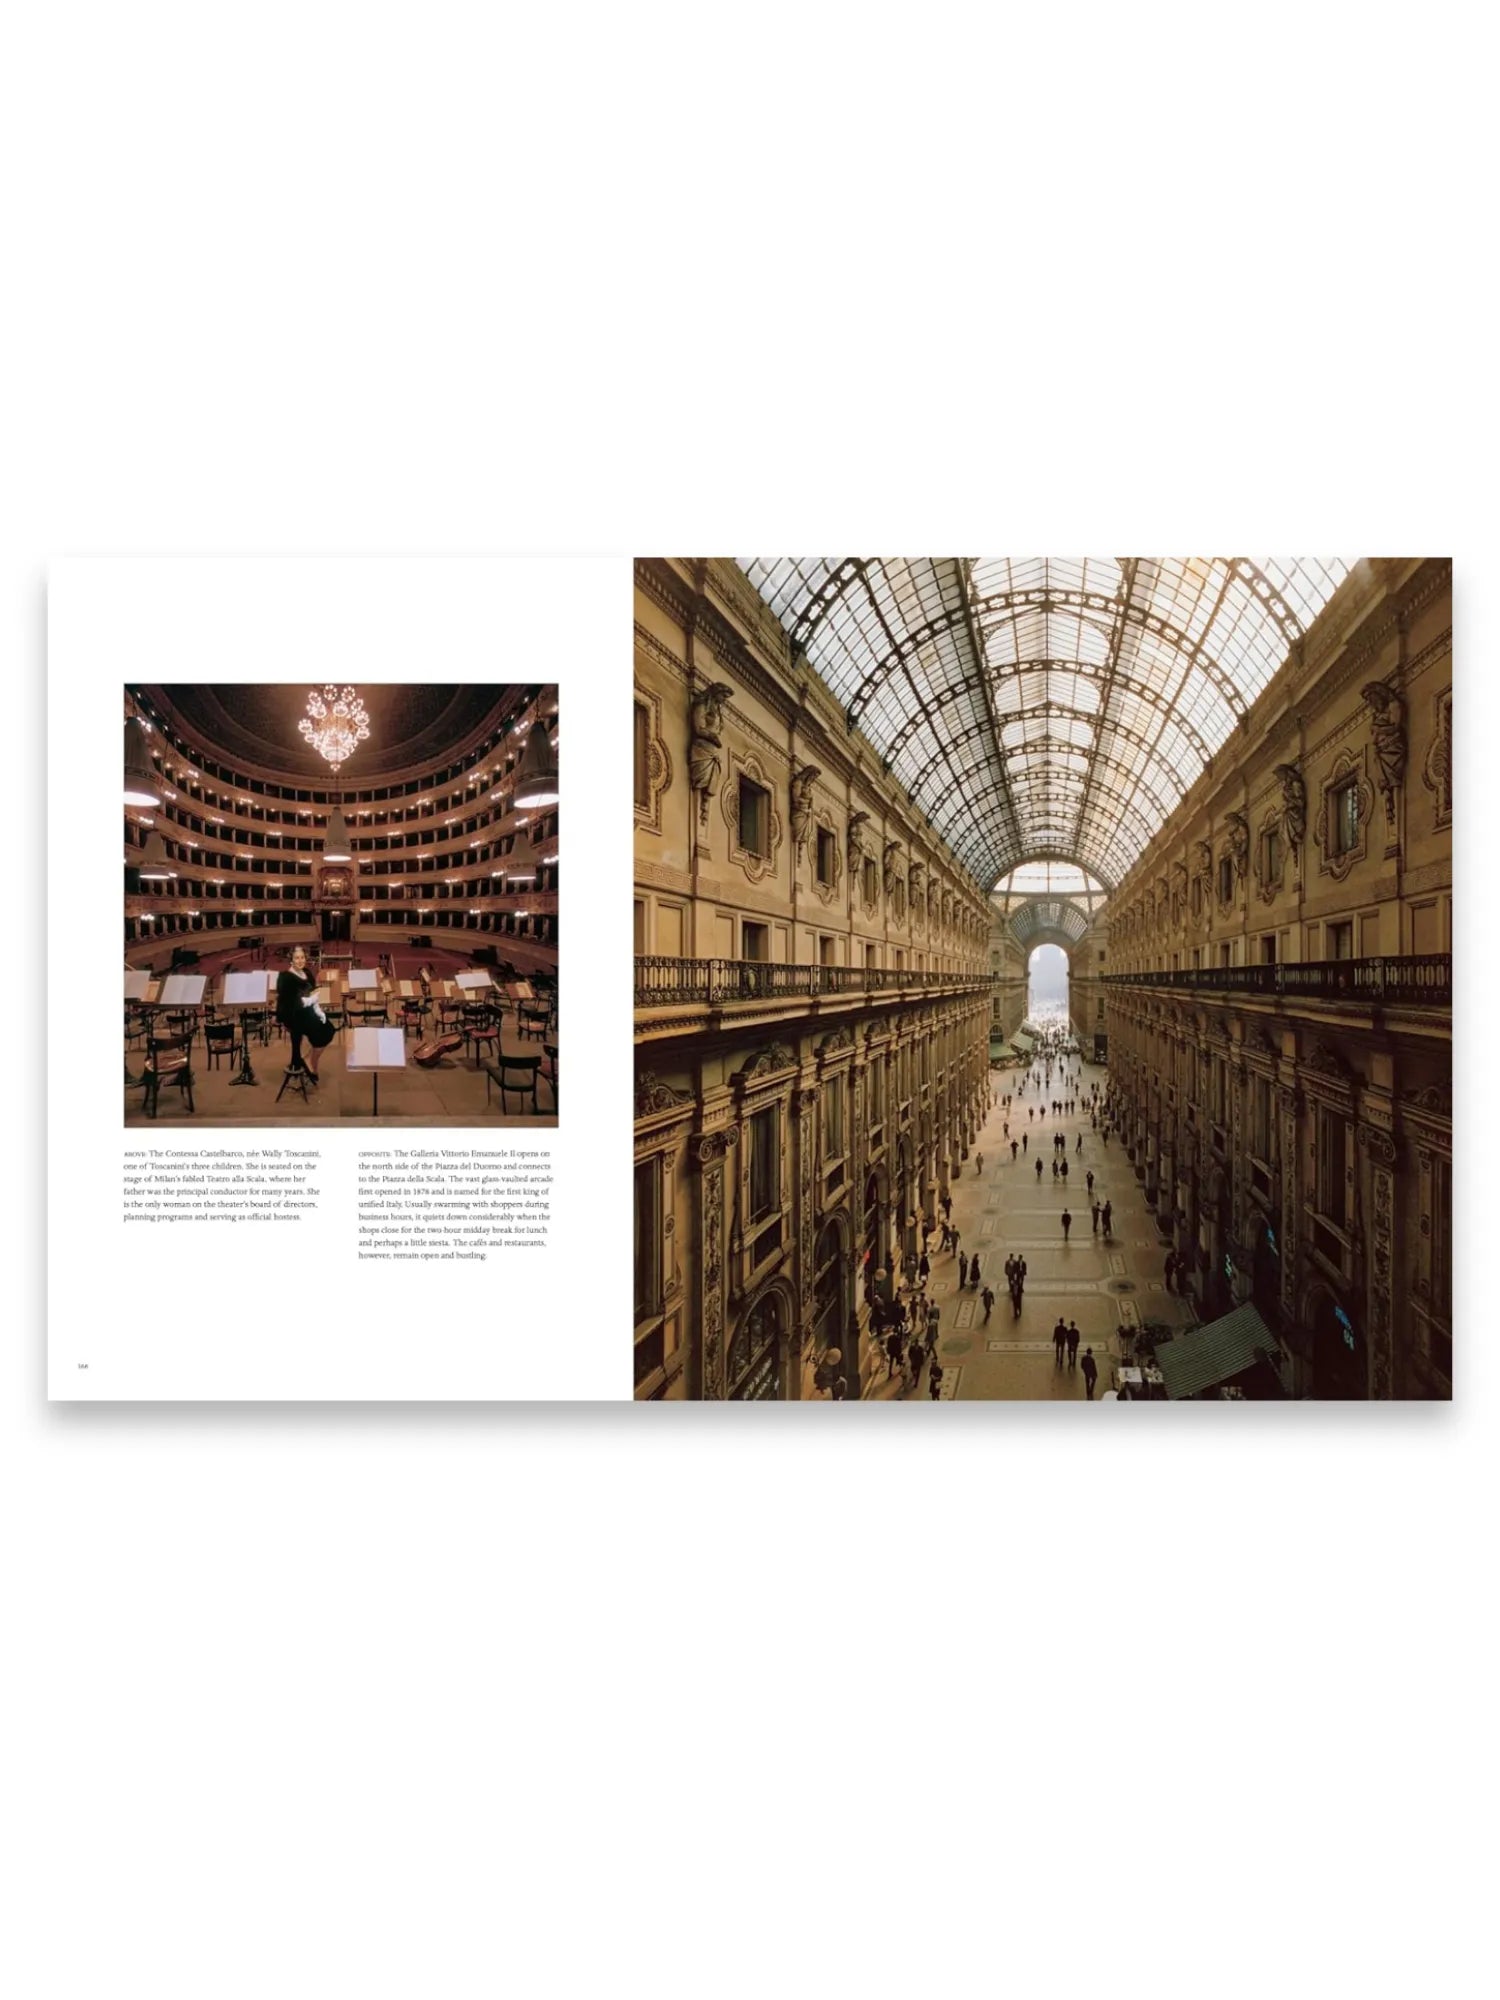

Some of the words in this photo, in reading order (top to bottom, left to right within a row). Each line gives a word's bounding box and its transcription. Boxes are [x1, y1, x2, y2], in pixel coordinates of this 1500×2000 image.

[149, 1149, 164, 1158] The
[261, 1149, 282, 1159] Wally
[394, 1149, 409, 1158] The
[410, 1149, 439, 1158] Galleria
[440, 1149, 470, 1158] Vittorio
[471, 1149, 508, 1158] Emanuele
[516, 1151, 539, 1160] opens
[138, 1162, 148, 1170] of
[191, 1162, 210, 1170] three
[245, 1162, 259, 1170] She
[268, 1162, 292, 1170] seated
[304, 1162, 317, 1170] the
[358, 1161, 371, 1170] the
[371, 1162, 393, 1171] north
[394, 1162, 409, 1170] side
[410, 1162, 420, 1170] of
[420, 1162, 433, 1170] the
[435, 1162, 459, 1170] Piazza
[459, 1162, 472, 1170] del
[473, 1162, 503, 1170] Duomo
[503, 1162, 517, 1170] and
[123, 1176, 143, 1185] stage
[143, 1174, 153, 1183] of
[182, 1174, 205, 1183] fabled
[206, 1175, 231, 1183] Teatro
[231, 1174, 245, 1183] alla
[268, 1175, 292, 1183] where
[293, 1174, 306, 1183] her
[368, 1175, 380, 1183] the
[382, 1175, 406, 1183] Piazza
[406, 1174, 425, 1183] della
[448, 1174, 464, 1183] The
[529, 1175, 554, 1183] arcade
[123, 1187, 146, 1196] father
[163, 1187, 175, 1196] the
[176, 1187, 209, 1198] principal
[209, 1187, 248, 1196] conductor
[249, 1187, 260, 1195] for
[261, 1189, 283, 1197] many
[307, 1187, 321, 1196] She
[358, 1187, 373, 1196] first
[374, 1188, 402, 1198] opened
[403, 1188, 411, 1196] in
[431, 1187, 445, 1196] and
[446, 1188, 453, 1196] is
[453, 1187, 480, 1196] named
[481, 1187, 492, 1196] for
[493, 1187, 506, 1196] the
[506, 1187, 521, 1196] first
[522, 1188, 540, 1197] king
[540, 1187, 549, 1196] of
[130, 1200, 144, 1208] the
[144, 1200, 161, 1210] only
[203, 1200, 217, 1208] the
[249, 1200, 272, 1208] board
[272, 1200, 282, 1208] of
[358, 1199, 385, 1208] unified
[404, 1200, 433, 1210] Usually
[433, 1202, 471, 1210] swarming
[471, 1200, 489, 1208] with
[490, 1200, 524, 1210] shoppers
[524, 1200, 550, 1210] during
[123, 1212, 156, 1223] planning
[157, 1214, 193, 1223] programs
[194, 1212, 208, 1221] and
[209, 1214, 237, 1223] serving
[247, 1212, 272, 1221] official
[358, 1212, 389, 1221] business
[415, 1213, 421, 1221] it
[422, 1213, 445, 1223] quiets
[446, 1212, 468, 1221] down
[468, 1212, 515, 1223] considerably
[516, 1212, 538, 1221] when
[538, 1212, 551, 1221] the
[358, 1226, 380, 1236] shops
[380, 1226, 400, 1234] close
[400, 1226, 412, 1234] for
[413, 1226, 426, 1234] the
[463, 1225, 491, 1236] midday
[492, 1226, 513, 1234] break
[514, 1226, 525, 1234] for
[526, 1226, 548, 1234] lunch
[358, 1238, 373, 1247] and
[373, 1238, 403, 1249] perhaps
[410, 1238, 427, 1247] little
[453, 1238, 468, 1247] The
[488, 1238, 503, 1247] and
[420, 1253, 440, 1261] open
[440, 1251, 455, 1259] and
